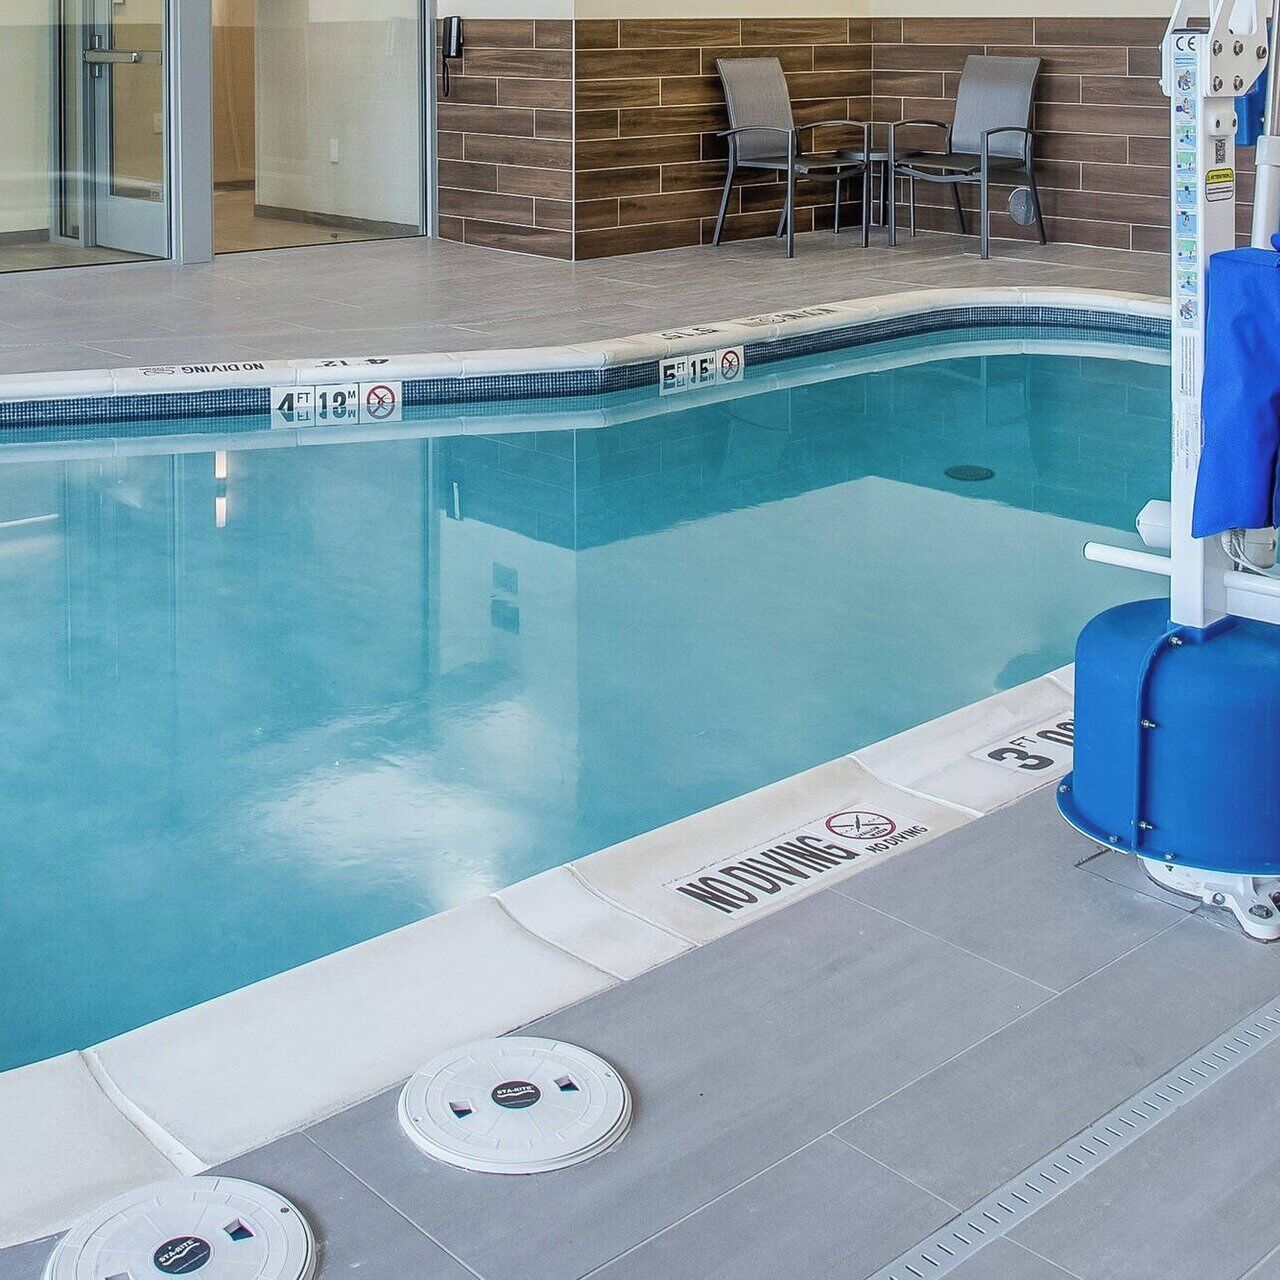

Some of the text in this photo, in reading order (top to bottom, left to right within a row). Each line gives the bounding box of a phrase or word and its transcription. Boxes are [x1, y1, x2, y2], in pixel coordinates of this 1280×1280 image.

[1176, 36, 1196, 51] CE
[181, 363, 241, 374] DIVING
[242, 362, 265, 370] NO
[297, 392, 311, 404] FT
[347, 390, 356, 399] M
[1009, 736, 1037, 748] FT
[988, 747, 1054, 770] 3
[865, 825, 929, 854] NO DIVING
[676, 835, 861, 914] NO DIVING
